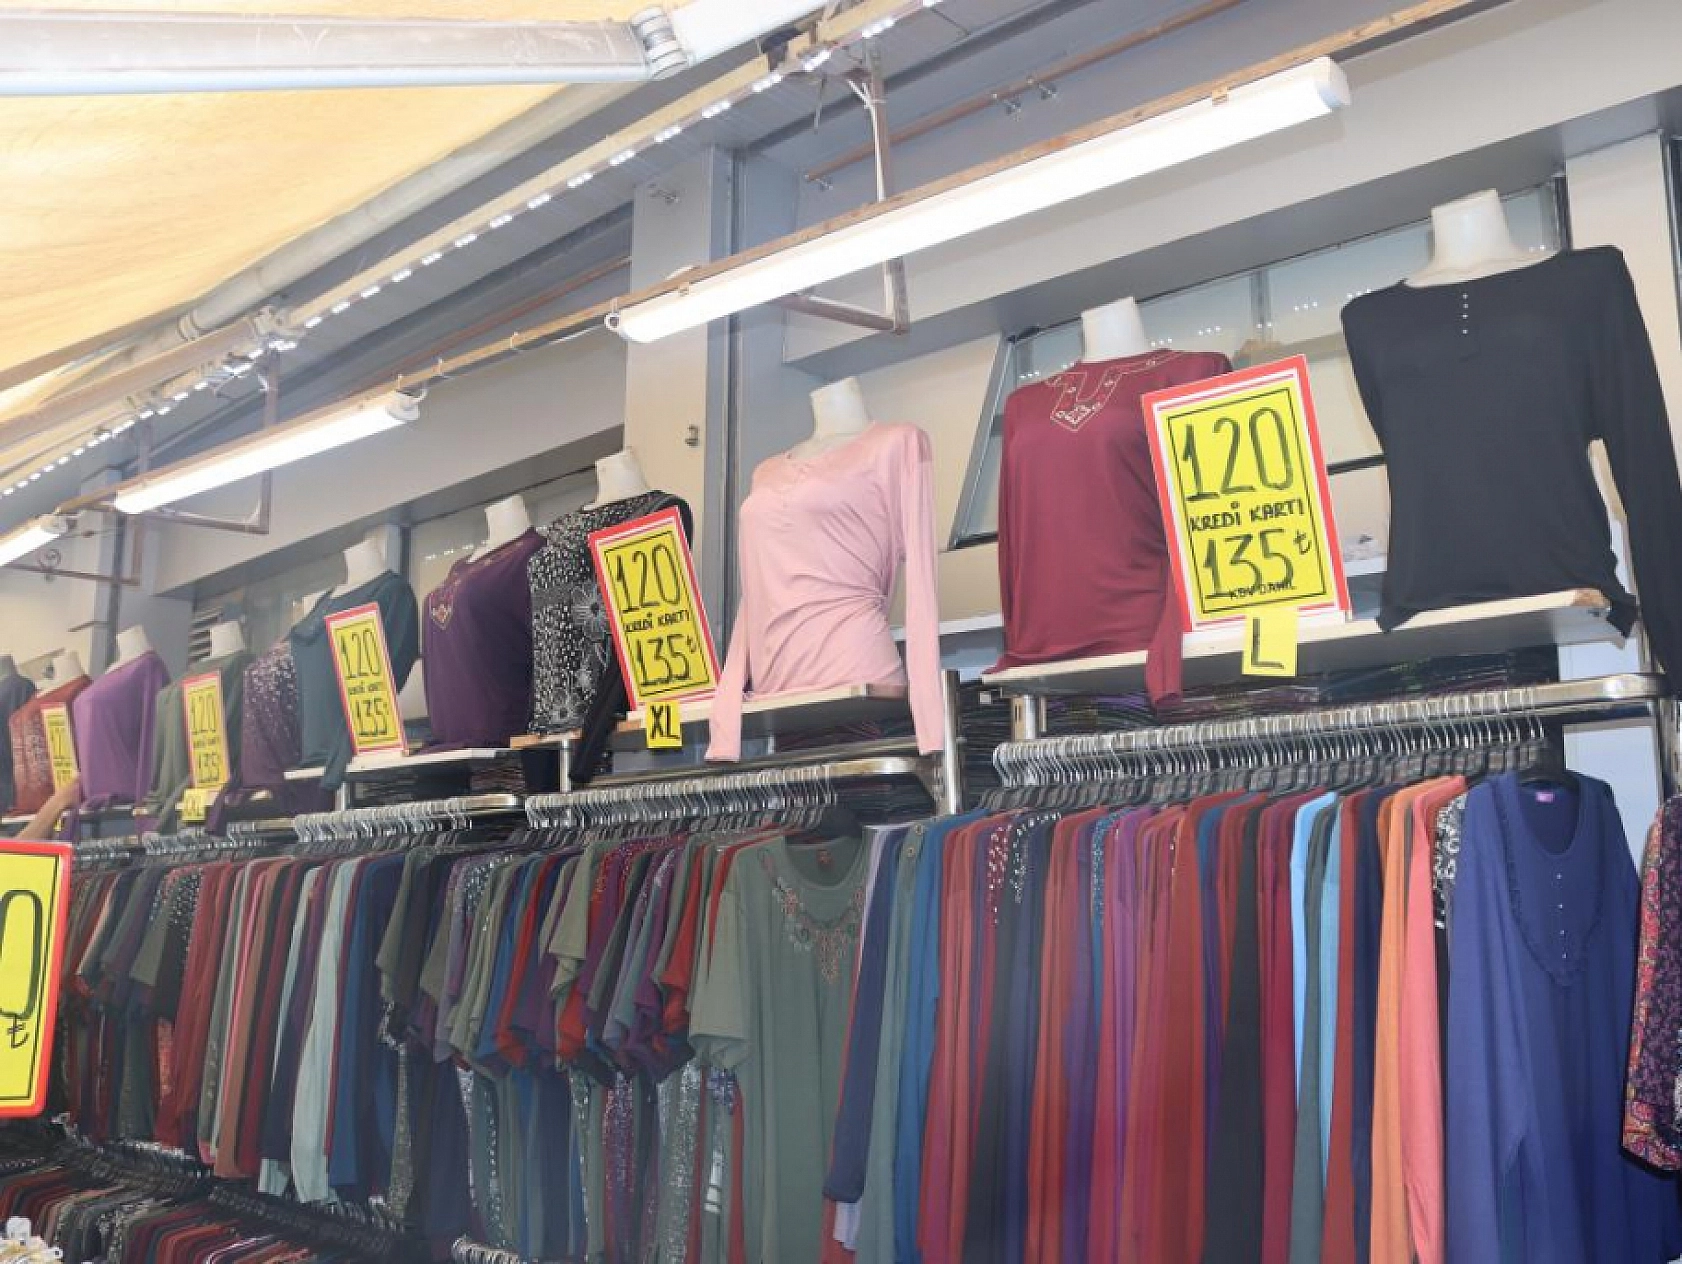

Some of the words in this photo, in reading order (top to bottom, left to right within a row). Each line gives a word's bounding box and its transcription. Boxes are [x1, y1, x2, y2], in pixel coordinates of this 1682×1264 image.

[1181, 406, 1294, 502] 120
[1189, 502, 1241, 532] KREDİ
[1249, 498, 1304, 525] KARTI
[616, 543, 681, 615] 120
[340, 628, 381, 680] 120
[1250, 617, 1285, 669] L
[649, 704, 680, 740] XL
